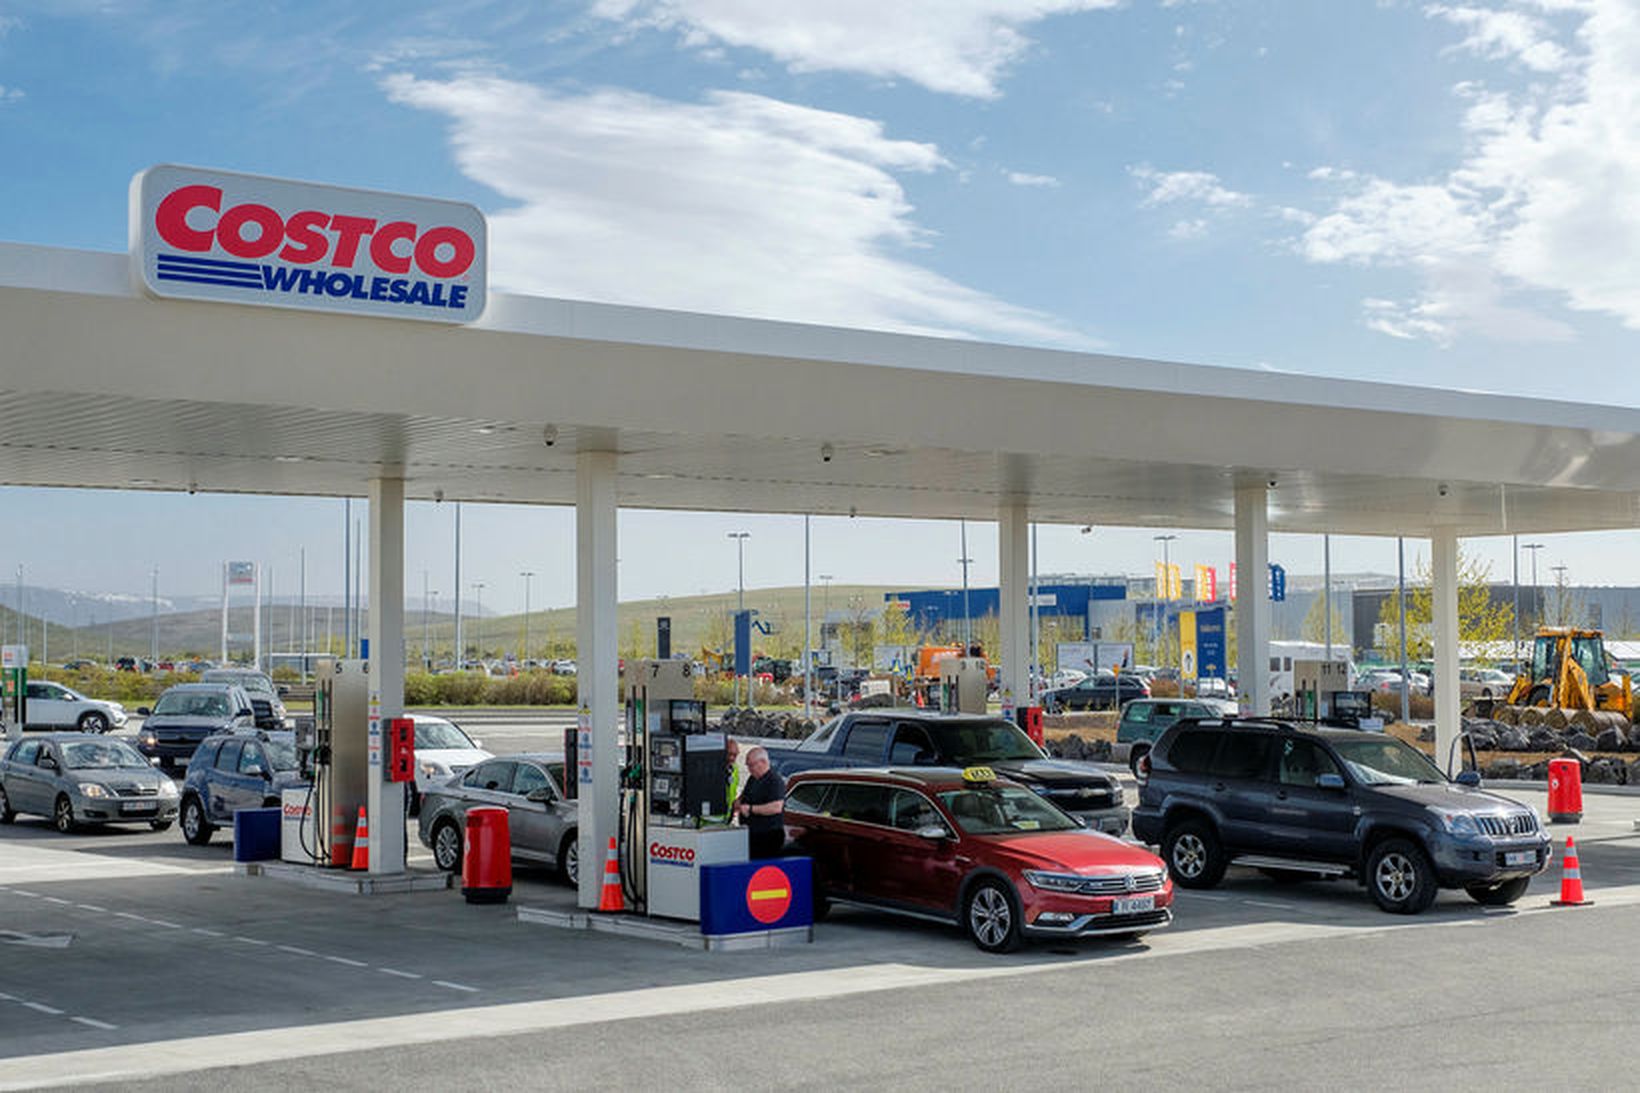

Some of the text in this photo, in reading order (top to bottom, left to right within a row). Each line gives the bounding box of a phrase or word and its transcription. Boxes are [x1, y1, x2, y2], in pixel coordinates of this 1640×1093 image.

[155, 185, 475, 278] COSTCO
[261, 265, 468, 308] WHOLESALE
[335, 661, 343, 674] 5
[651, 662, 691, 678] 7 8
[650, 841, 695, 862] COSTCO
